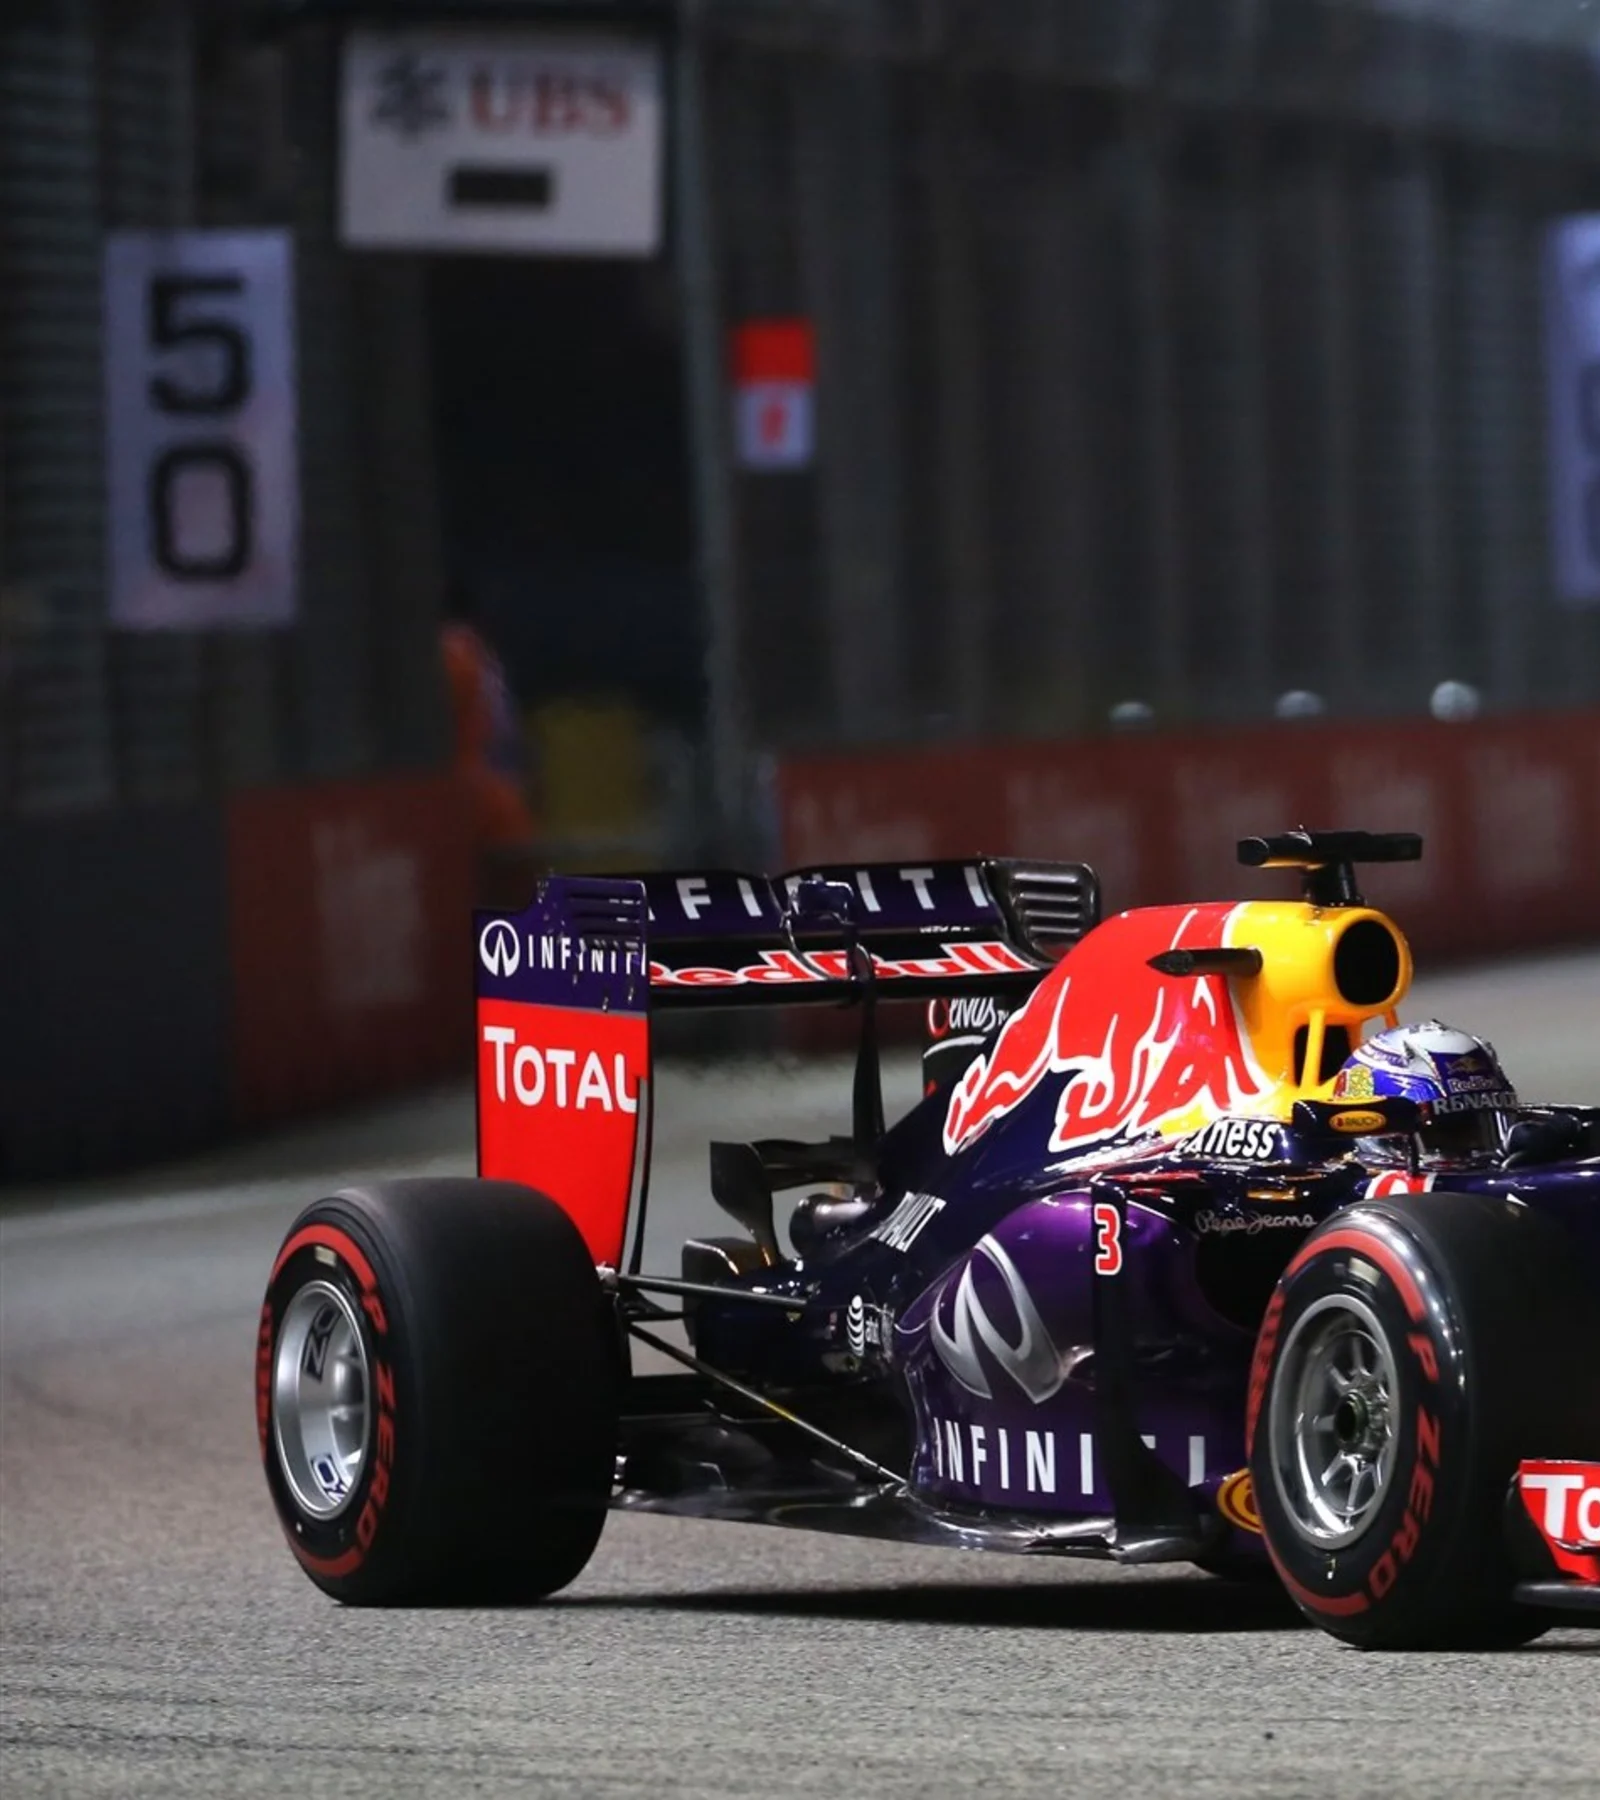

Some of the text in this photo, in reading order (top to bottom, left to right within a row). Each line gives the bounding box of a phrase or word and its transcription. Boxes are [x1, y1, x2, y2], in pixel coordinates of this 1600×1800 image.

[468, 64, 632, 134] UBS
[148, 270, 252, 582] 50
[484, 1026, 638, 1114] TOTAL
[1094, 1203, 1122, 1275] 3
[934, 1416, 1206, 1496] INFINII
